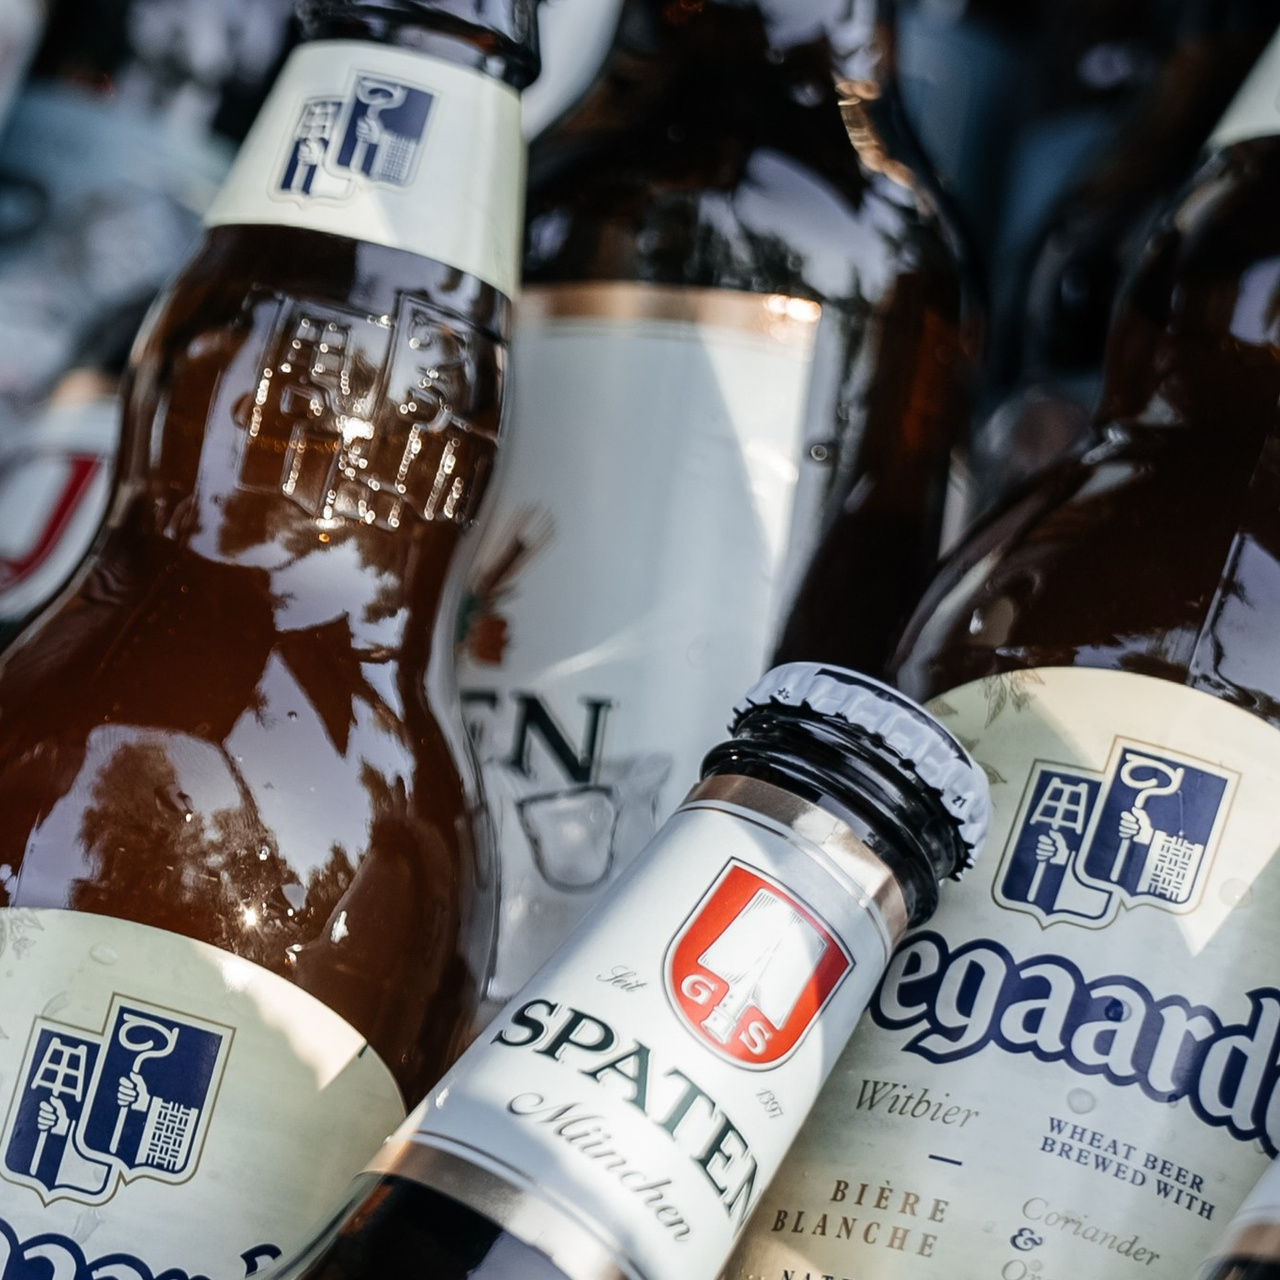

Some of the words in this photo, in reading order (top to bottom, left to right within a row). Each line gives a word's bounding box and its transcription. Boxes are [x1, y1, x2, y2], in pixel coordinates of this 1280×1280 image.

[596, 964, 648, 993] Seit
[680, 974, 717, 1005] G
[738, 1020, 771, 1056] S
[870, 930, 1280, 1160] egaard
[854, 1078, 981, 1130] Witbier
[506, 1091, 692, 1243] München
[1040, 1136, 1147, 1189] BREWED
[1155, 1178, 1217, 1221] WITH
[1046, 1116, 1137, 1162] WHEAT
[1142, 1151, 1205, 1195] BEER
[771, 1208, 939, 1260] BLANCHE
[830, 1178, 951, 1225] BIÈRE
[1021, 1195, 1161, 1267] Coriander
[1009, 1227, 1045, 1253] &
